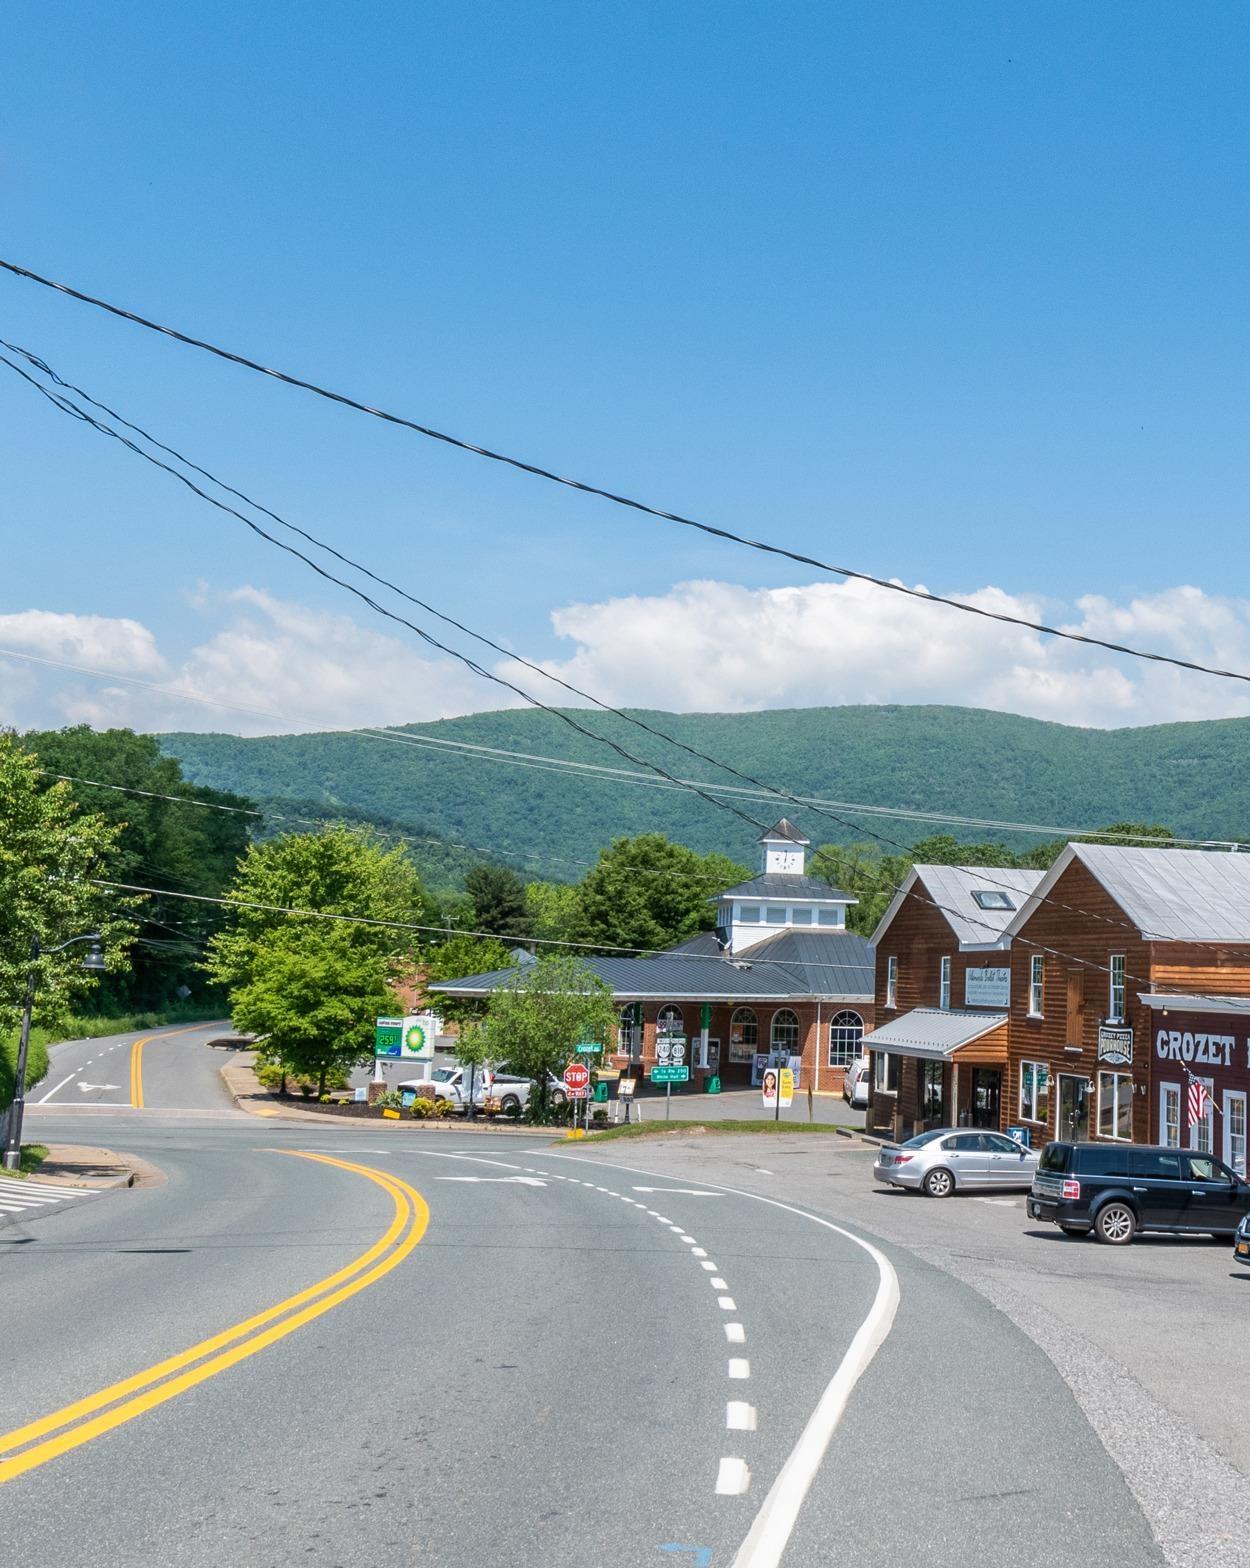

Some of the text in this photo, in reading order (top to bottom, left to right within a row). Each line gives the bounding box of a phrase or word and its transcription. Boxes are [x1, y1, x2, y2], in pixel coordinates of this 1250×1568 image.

[659, 1045, 670, 1053] 240
[674, 1046, 683, 1055] 810
[1156, 1030, 1235, 1066] CROZET
[565, 1071, 588, 1082] STOP
